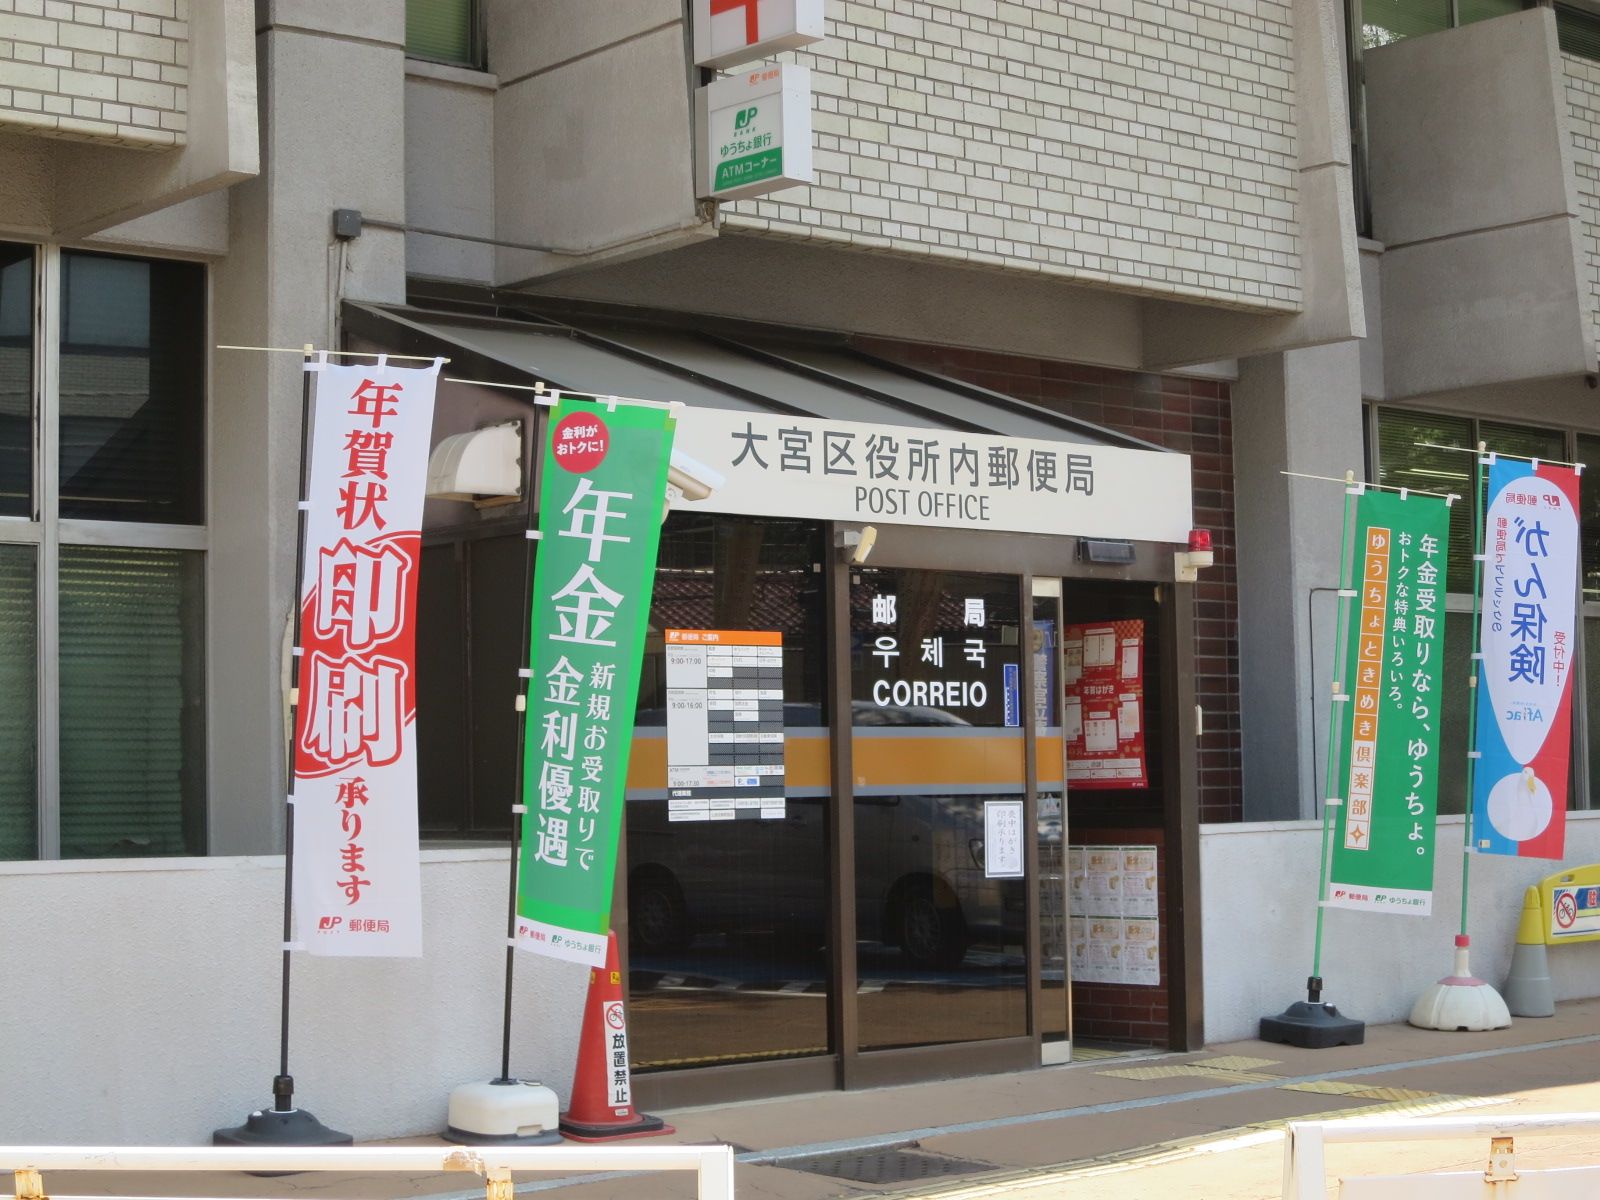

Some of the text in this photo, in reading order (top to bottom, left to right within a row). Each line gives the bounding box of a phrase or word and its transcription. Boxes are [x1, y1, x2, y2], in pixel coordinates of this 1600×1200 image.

[720, 133, 772, 158] ゆうちょ銀行
[735, 107, 758, 130] JP
[722, 156, 777, 179] ATMコーナー
[336, 378, 403, 531] 年賀状
[556, 439, 604, 456] おトクに!
[561, 425, 598, 440] 金利が
[731, 421, 1095, 497] 大宮区役所内郵便局
[855, 486, 991, 521] POST OFFICE
[549, 477, 633, 648] 年金
[1388, 531, 1412, 710] おトクな特典いろいろ。
[873, 679, 988, 708] CORREIO
[1351, 533, 1387, 816] ゆうちょときめき倶楽部
[1405, 533, 1440, 856] 年金受取りなら、ゆうちょ。
[535, 655, 584, 868] 金利優遇
[575, 662, 617, 871] 新規お受取りで
[335, 776, 371, 906] 承ります
[319, 916, 390, 933] JP 郵便局
[612, 1033, 628, 1104] 放置禁止
